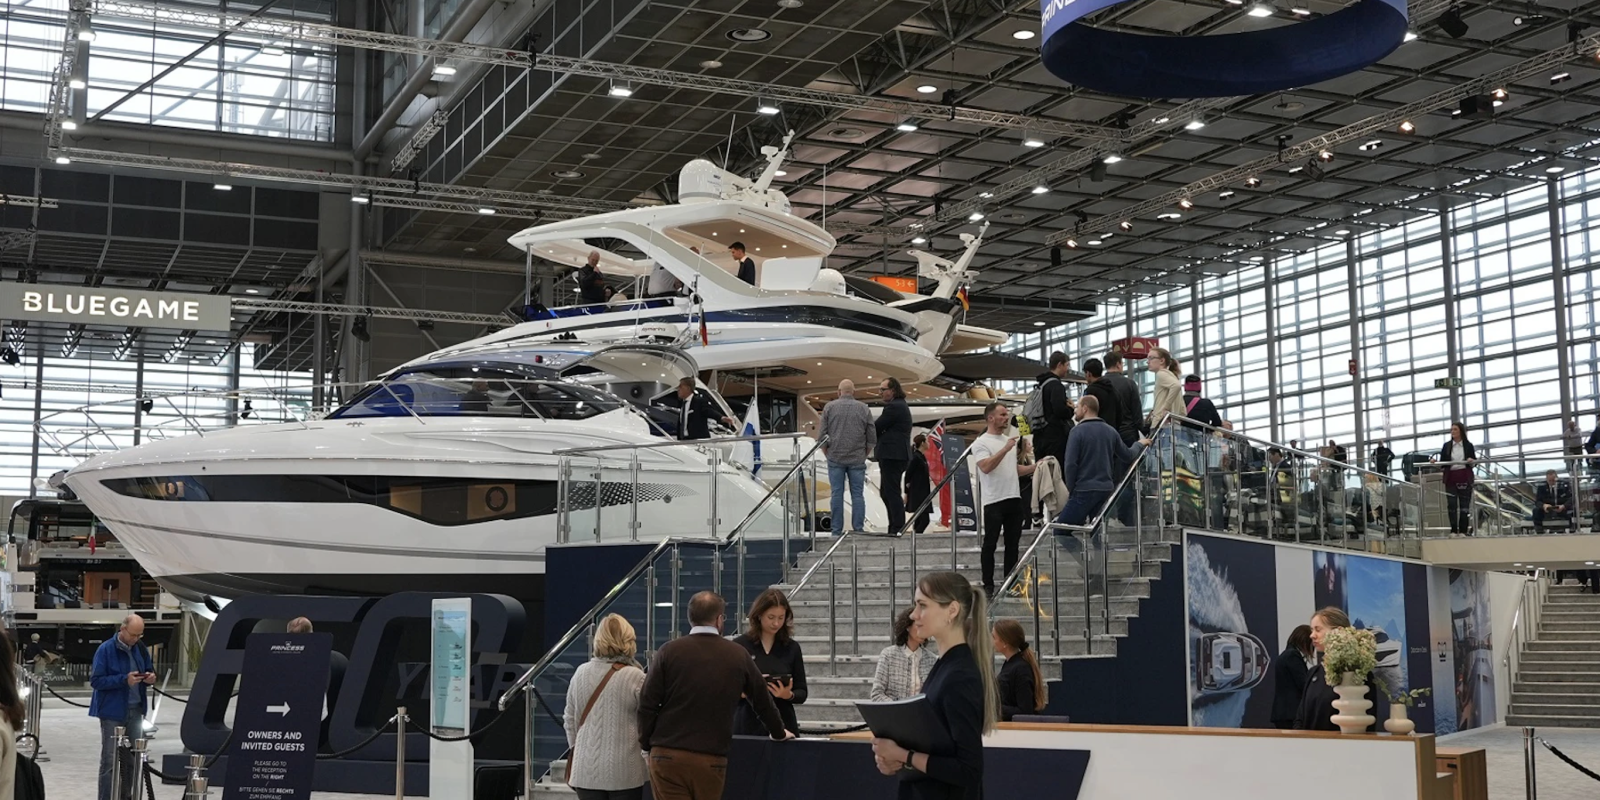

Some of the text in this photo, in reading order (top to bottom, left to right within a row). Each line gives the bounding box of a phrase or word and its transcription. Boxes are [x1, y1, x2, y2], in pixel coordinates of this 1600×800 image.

[23, 292, 199, 321] BLUEGAME
[248, 731, 302, 740] OWNERS AND
[241, 742, 305, 751] INVITED GUESTS
